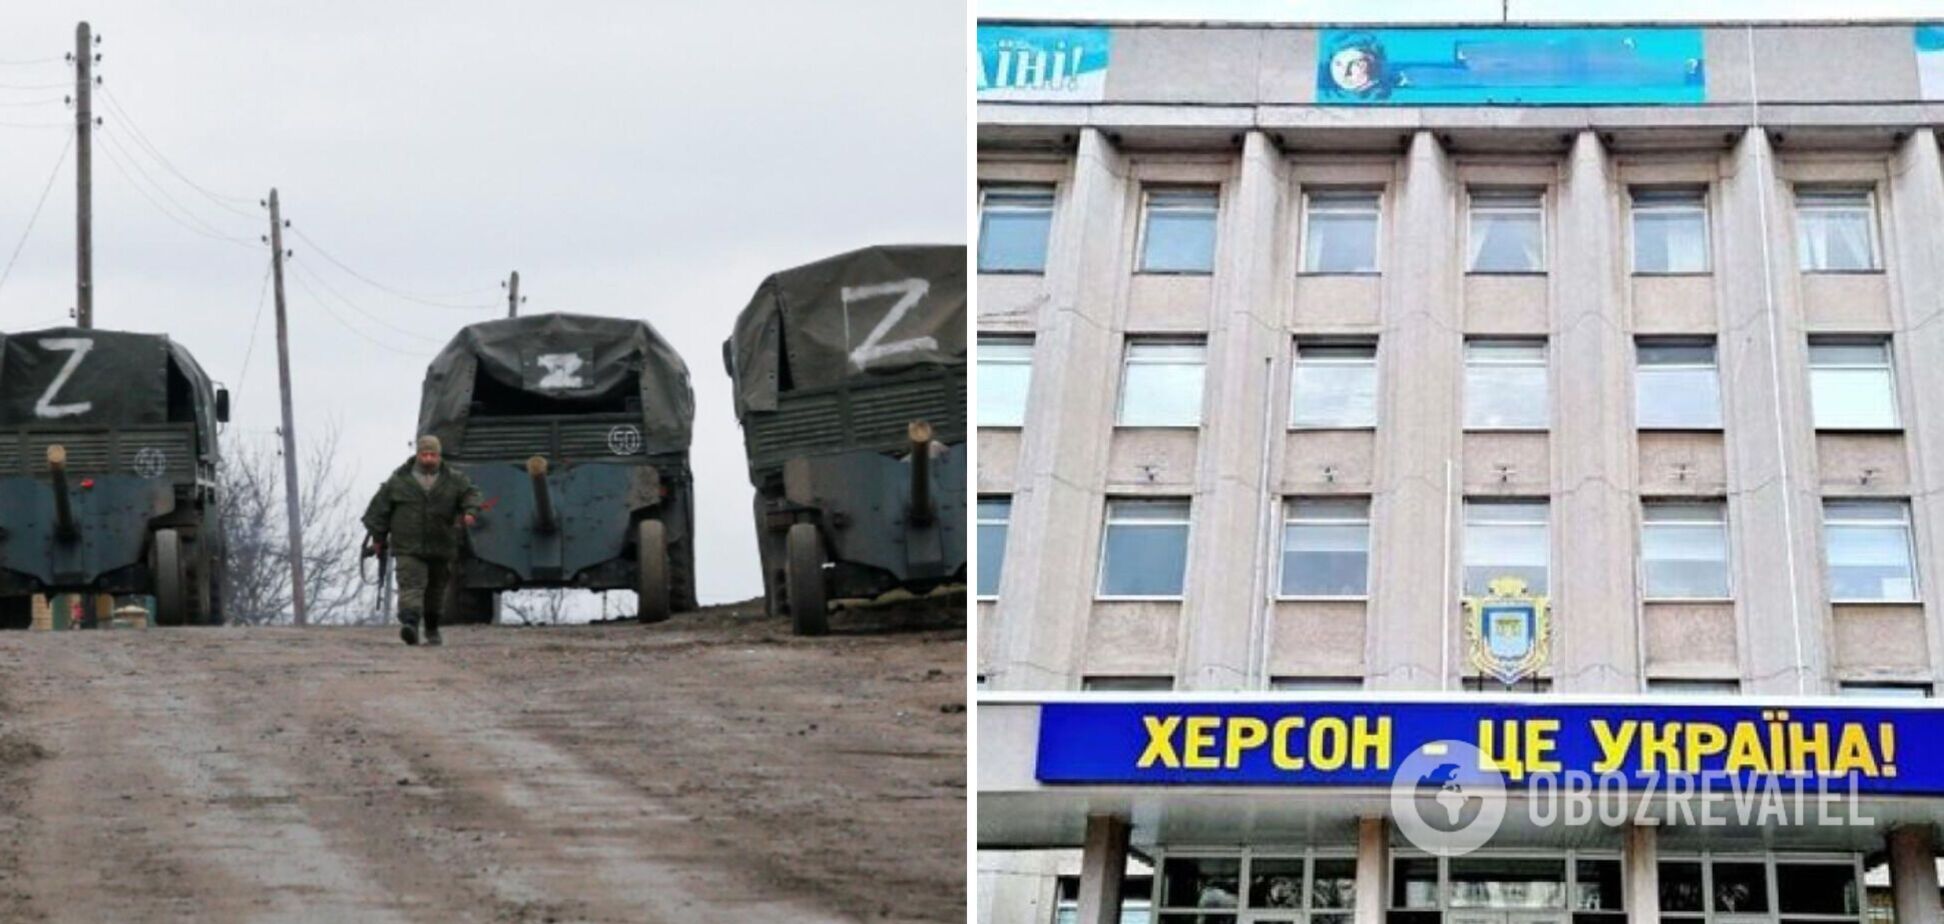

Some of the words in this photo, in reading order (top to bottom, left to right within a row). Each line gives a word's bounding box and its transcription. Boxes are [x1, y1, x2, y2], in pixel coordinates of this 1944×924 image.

[843, 277, 940, 371] Z
[34, 337, 95, 418] Z
[1136, 715, 1392, 770] ХЕРСОН
[1421, 742, 1449, 756] -
[1478, 719, 1561, 780] ЦЕ
[1590, 710, 1898, 778] УКРАЇНА!
